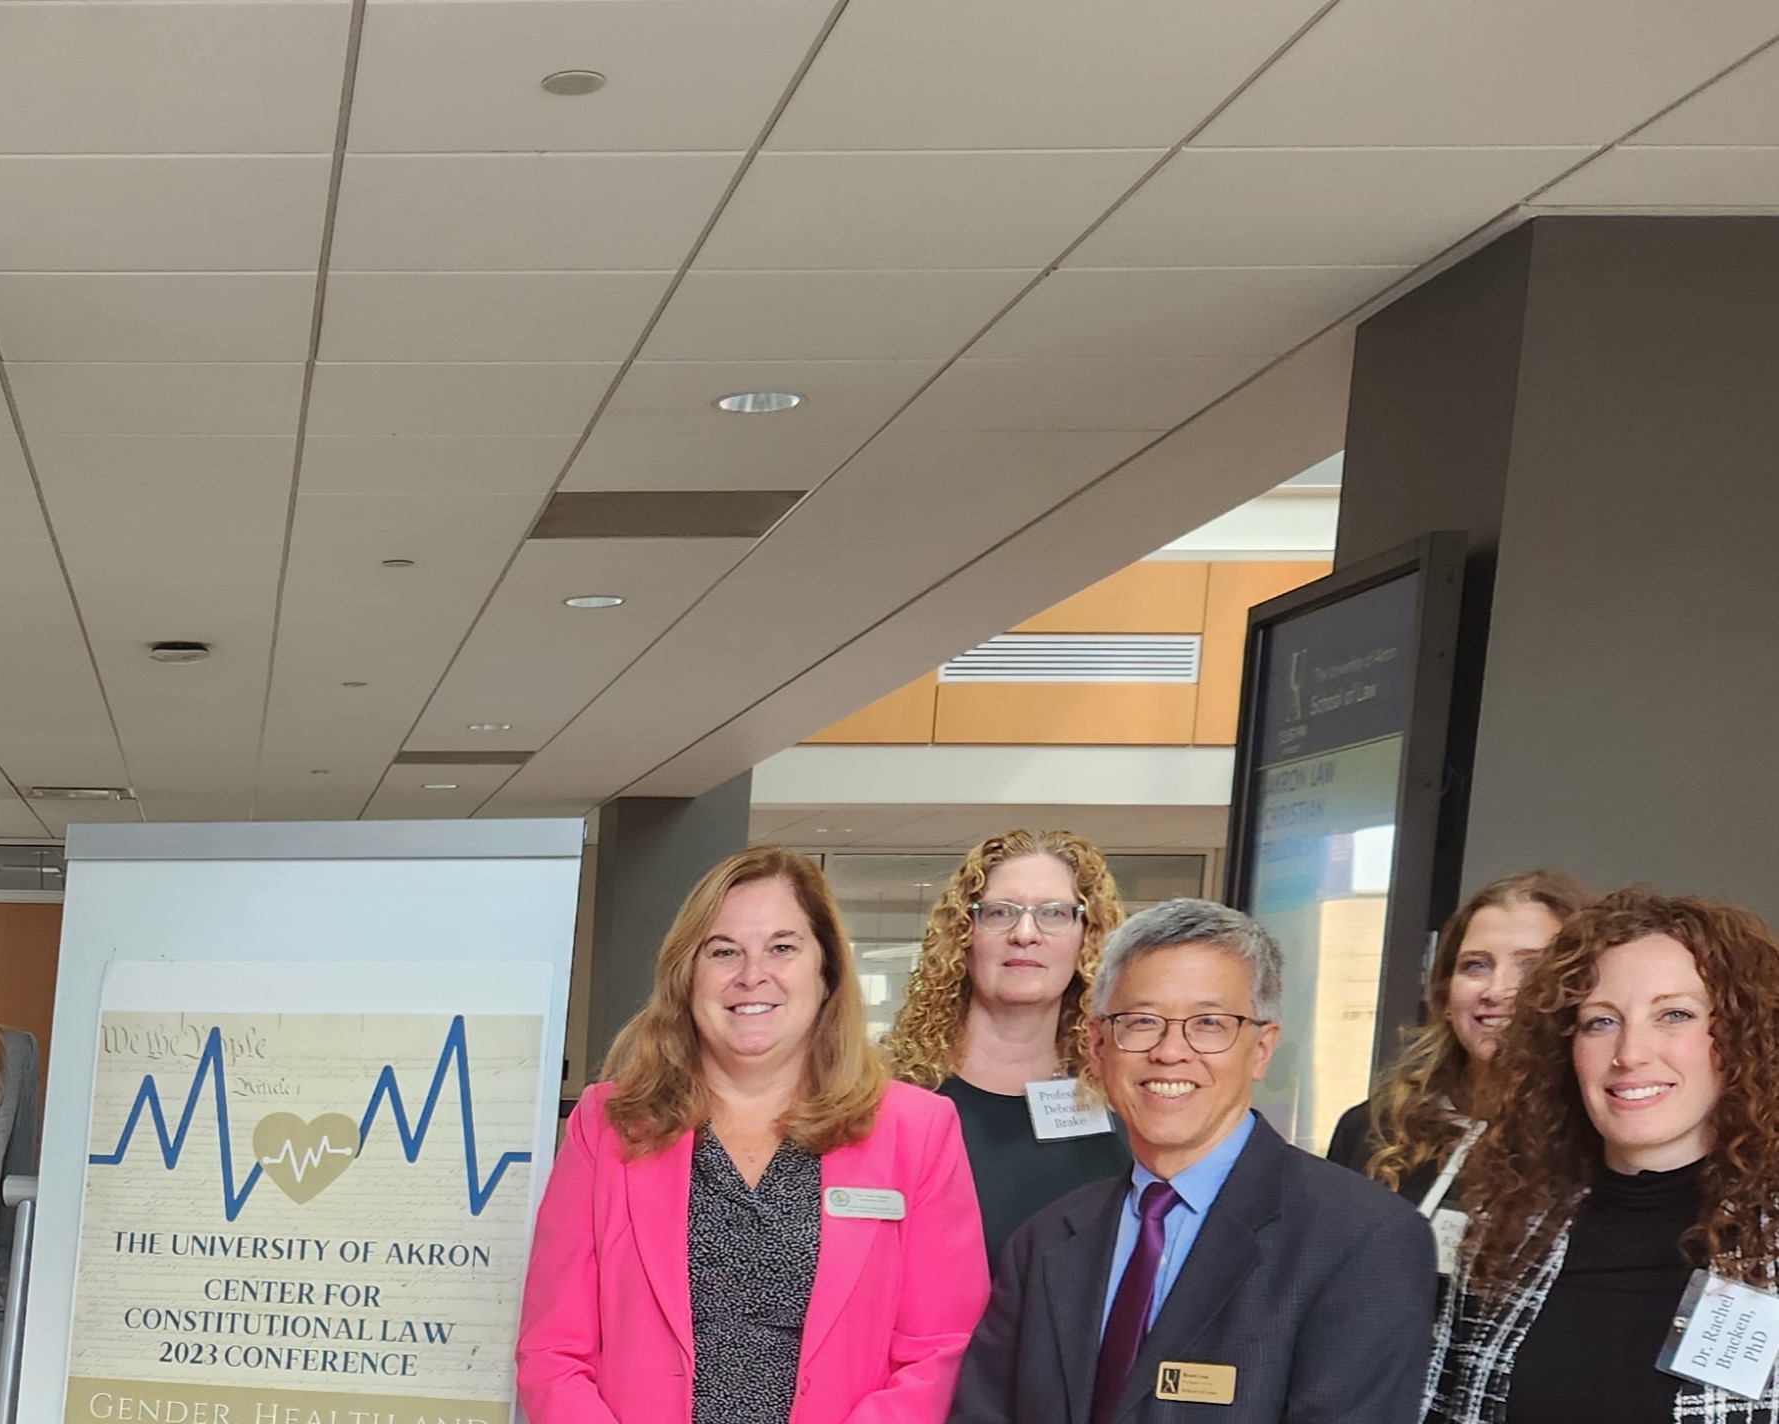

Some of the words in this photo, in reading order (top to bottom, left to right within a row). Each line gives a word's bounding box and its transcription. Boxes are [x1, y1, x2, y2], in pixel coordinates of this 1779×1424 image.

[1054, 1116, 1087, 1128] Brake
[112, 1231, 162, 1255] THE
[172, 1234, 331, 1262] UNIVERSITY
[339, 1240, 378, 1263] OF
[385, 1242, 491, 1268] AKRON
[204, 1279, 315, 1305] CENTER
[324, 1284, 381, 1308] FOR
[124, 1308, 373, 1342] CONSTITUTIONAL
[380, 1319, 456, 1345] LAW
[1702, 1293, 1735, 1342] Rachel
[1691, 1347, 1714, 1368] Dr.
[1716, 1310, 1757, 1369] Bracken,
[1743, 1330, 1768, 1363] PhD
[158, 1341, 218, 1366] 2023
[224, 1345, 418, 1377] CONFERENCE
